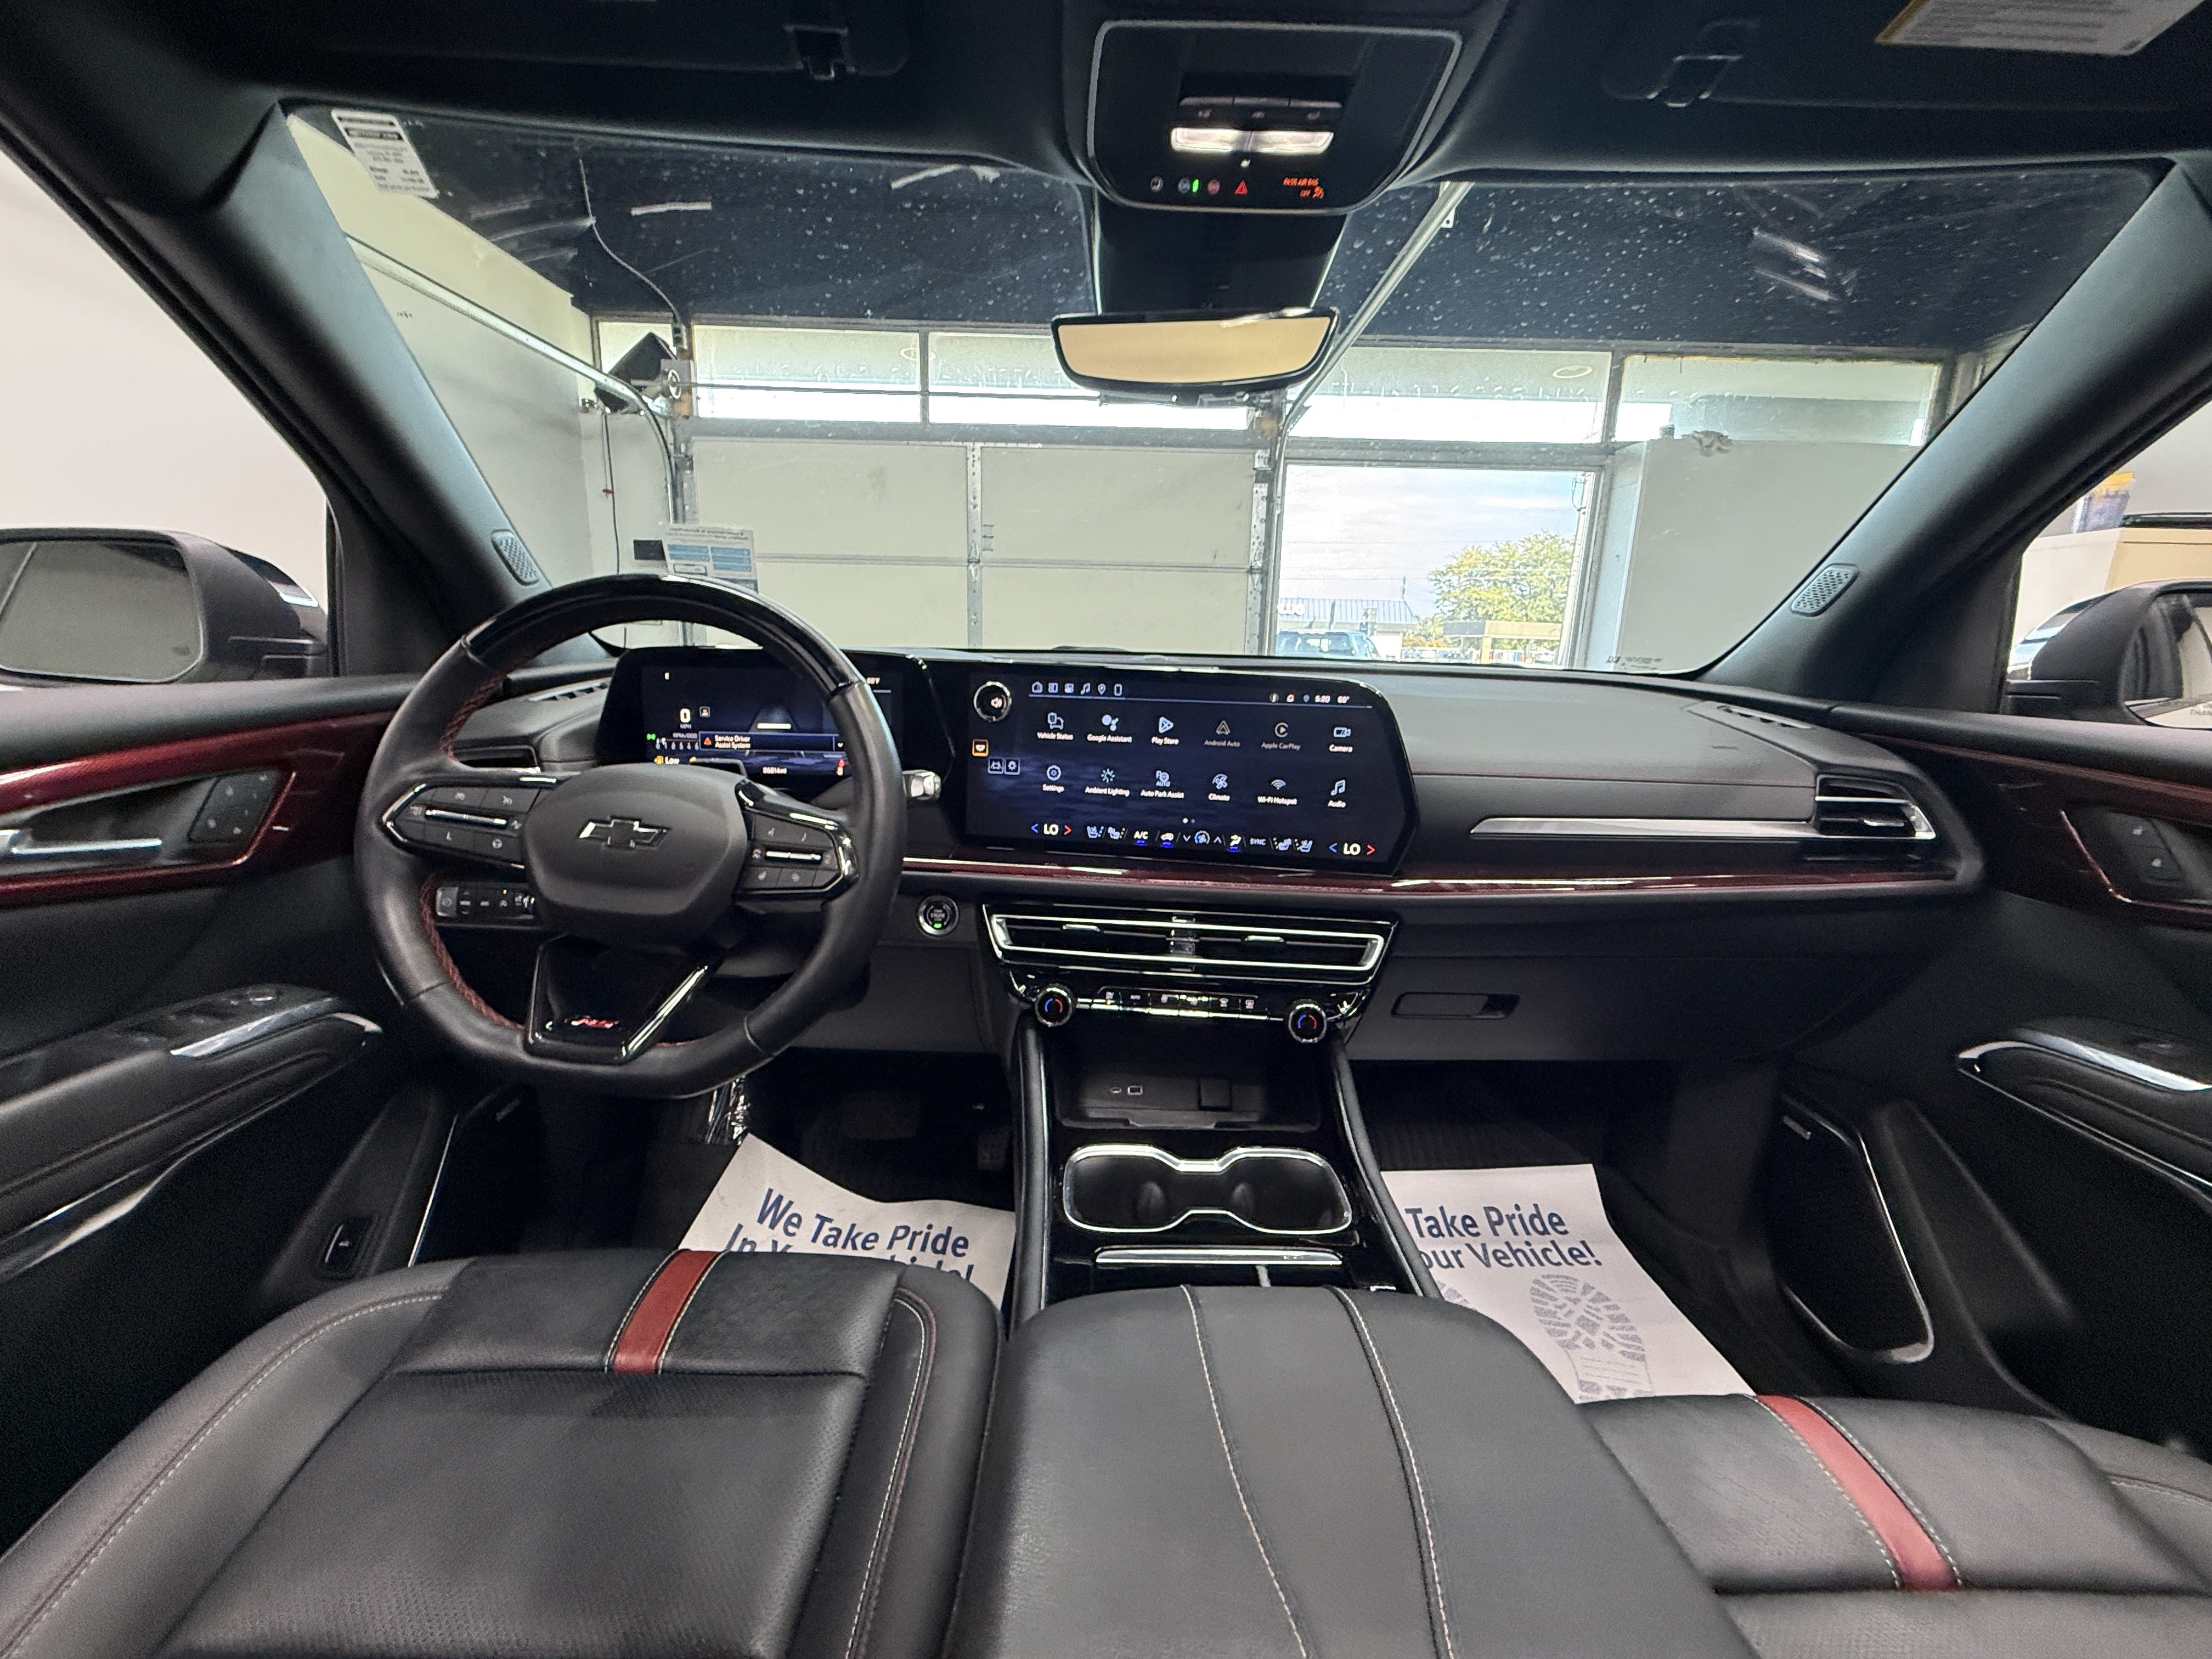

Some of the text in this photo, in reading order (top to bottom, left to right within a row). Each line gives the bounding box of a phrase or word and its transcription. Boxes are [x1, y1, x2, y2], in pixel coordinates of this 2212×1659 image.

[680, 708, 691, 723] 0
[1087, 733, 1132, 743] Google Assistant
[1152, 736, 1179, 745] Play Store
[1261, 742, 1302, 751] Apple CarPlay
[1329, 744, 1353, 753] Camera
[665, 756, 680, 764] Low
[1042, 784, 1064, 793] Settings
[1085, 786, 1130, 797] Ambient Lighting
[1167, 791, 1184, 799] Assist
[1208, 793, 1231, 801] Climate
[1273, 797, 1297, 806] Hotspot
[1328, 800, 1346, 808] Audio
[1043, 823, 1059, 836] LO
[1133, 831, 1148, 840] A/C
[1250, 838, 1267, 846] SYNC
[1343, 843, 1361, 855] LO
[757, 1188, 969, 1257] We Take Pride
[1404, 1203, 1570, 1238] Take Pride
[1464, 1240, 1602, 1268] Vehicle!
